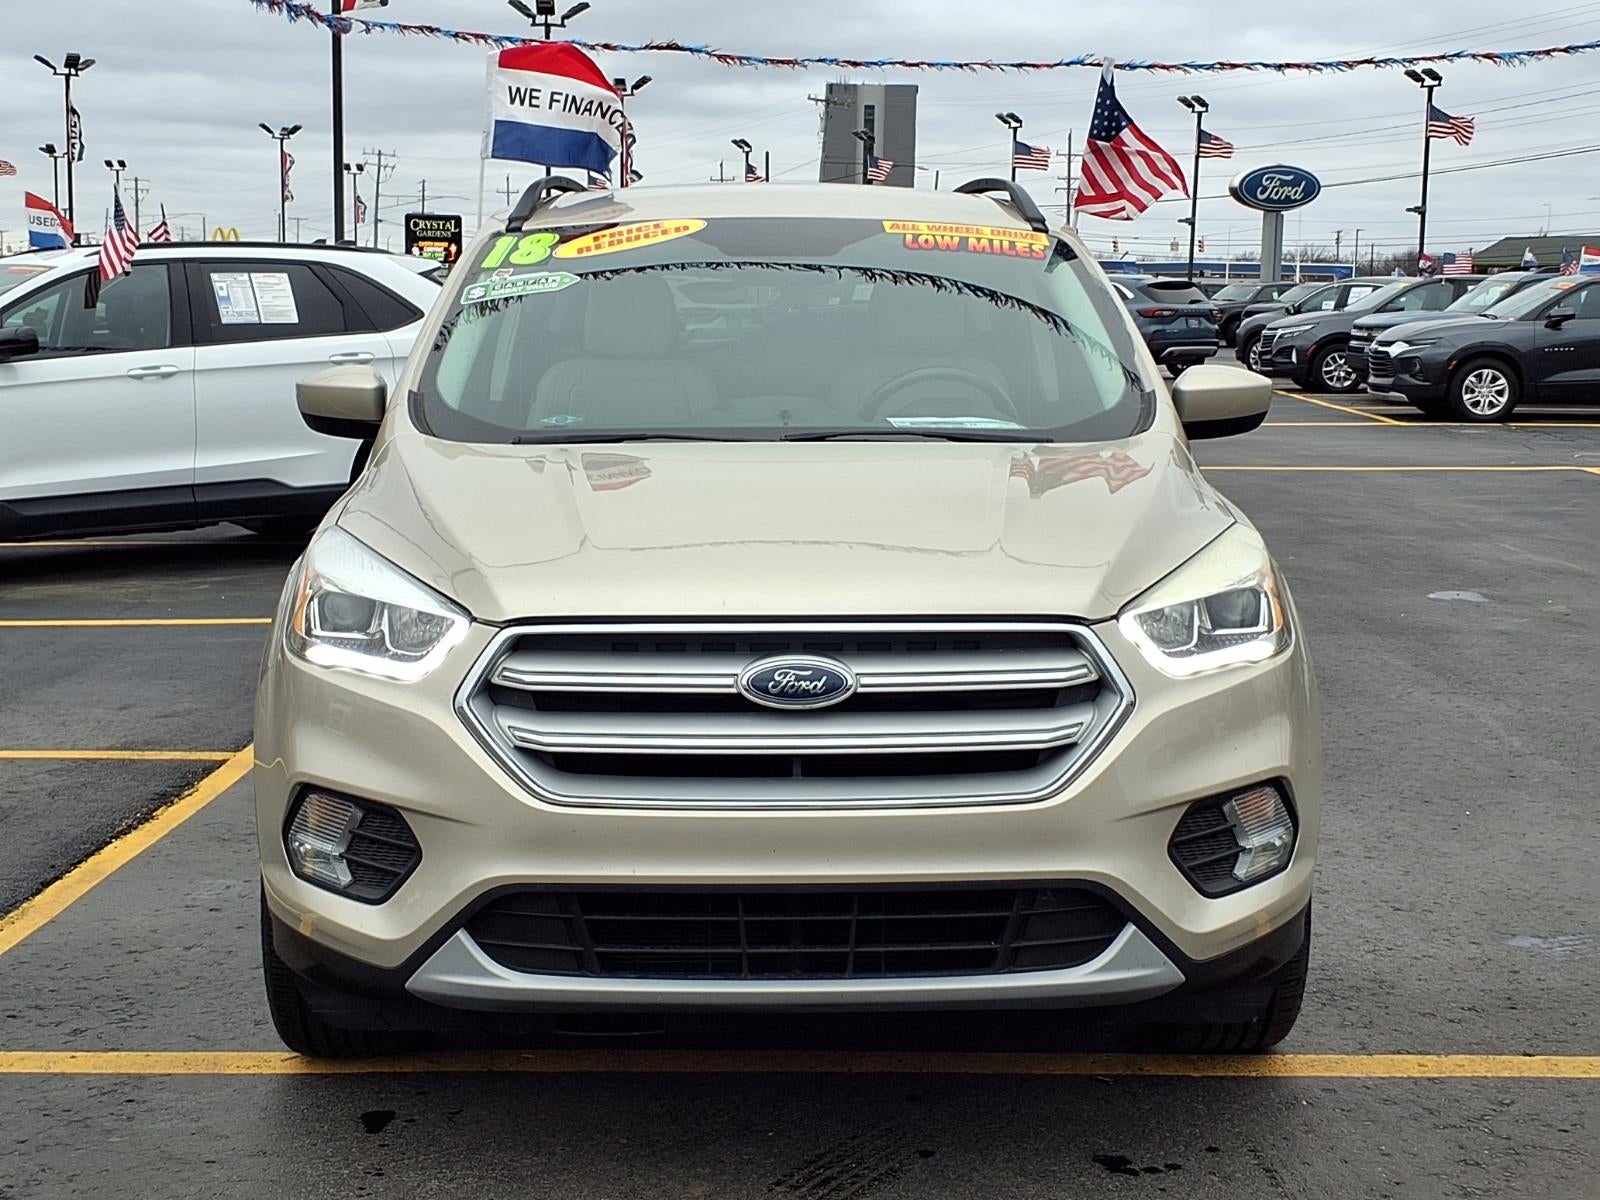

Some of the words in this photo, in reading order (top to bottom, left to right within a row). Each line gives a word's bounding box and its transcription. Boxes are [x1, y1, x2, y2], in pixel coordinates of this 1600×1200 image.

[508, 85, 541, 108] WE
[1256, 173, 1306, 200] Ford
[29, 214, 57, 227] USED
[410, 218, 459, 232] CRYSTAL
[889, 222, 920, 232] ALL
[926, 224, 985, 235] WHEEL
[990, 229, 1042, 240] DRIVE
[416, 230, 452, 238] GARDENS
[577, 225, 690, 255] REDUCED
[592, 222, 664, 243] PRICE
[481, 233, 560, 268] 18
[904, 234, 960, 251] LOW
[968, 237, 1046, 261] MILES
[768, 669, 828, 694] Ford
